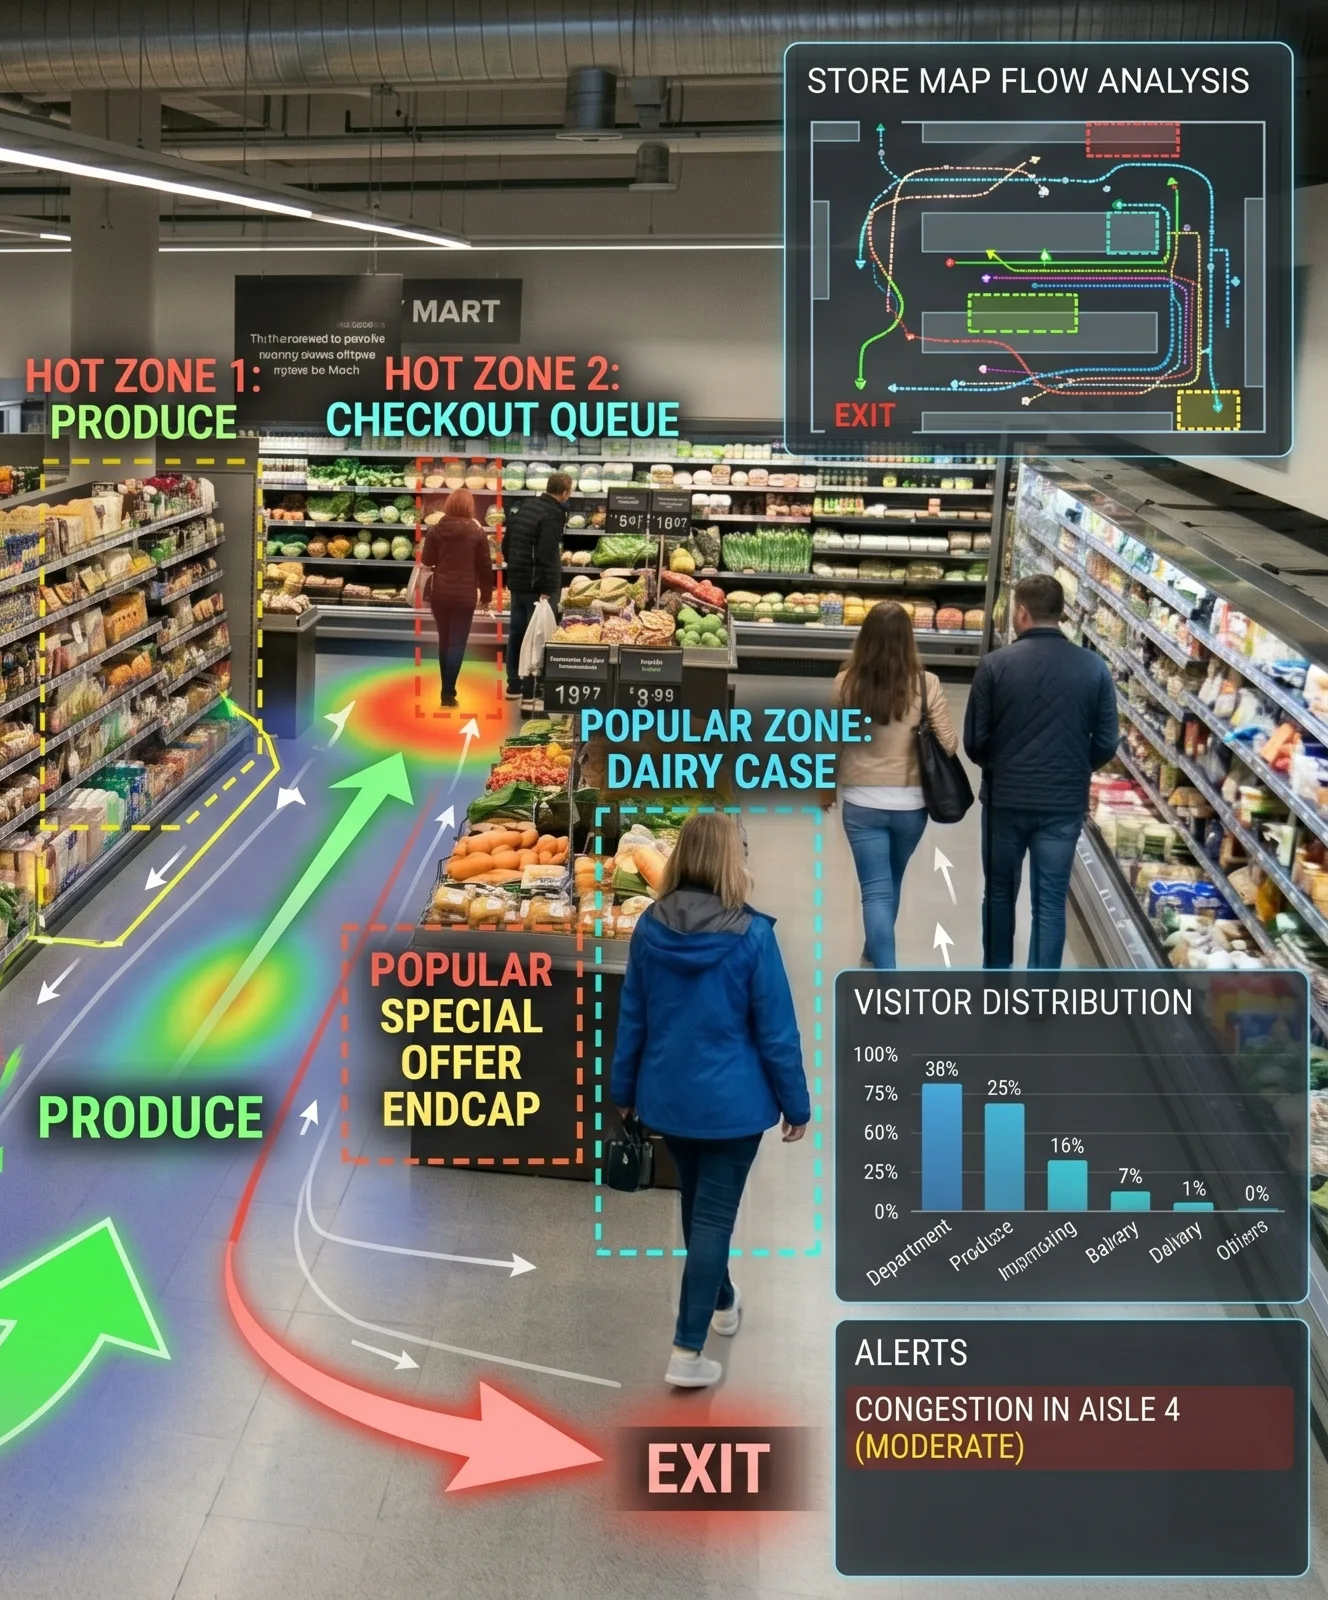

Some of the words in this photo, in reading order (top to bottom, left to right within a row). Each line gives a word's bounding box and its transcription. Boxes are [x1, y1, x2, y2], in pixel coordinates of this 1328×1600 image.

[411, 299, 501, 323] MART
[331, 333, 342, 344] to
[311, 364, 325, 375] be
[328, 364, 360, 375] Mach
